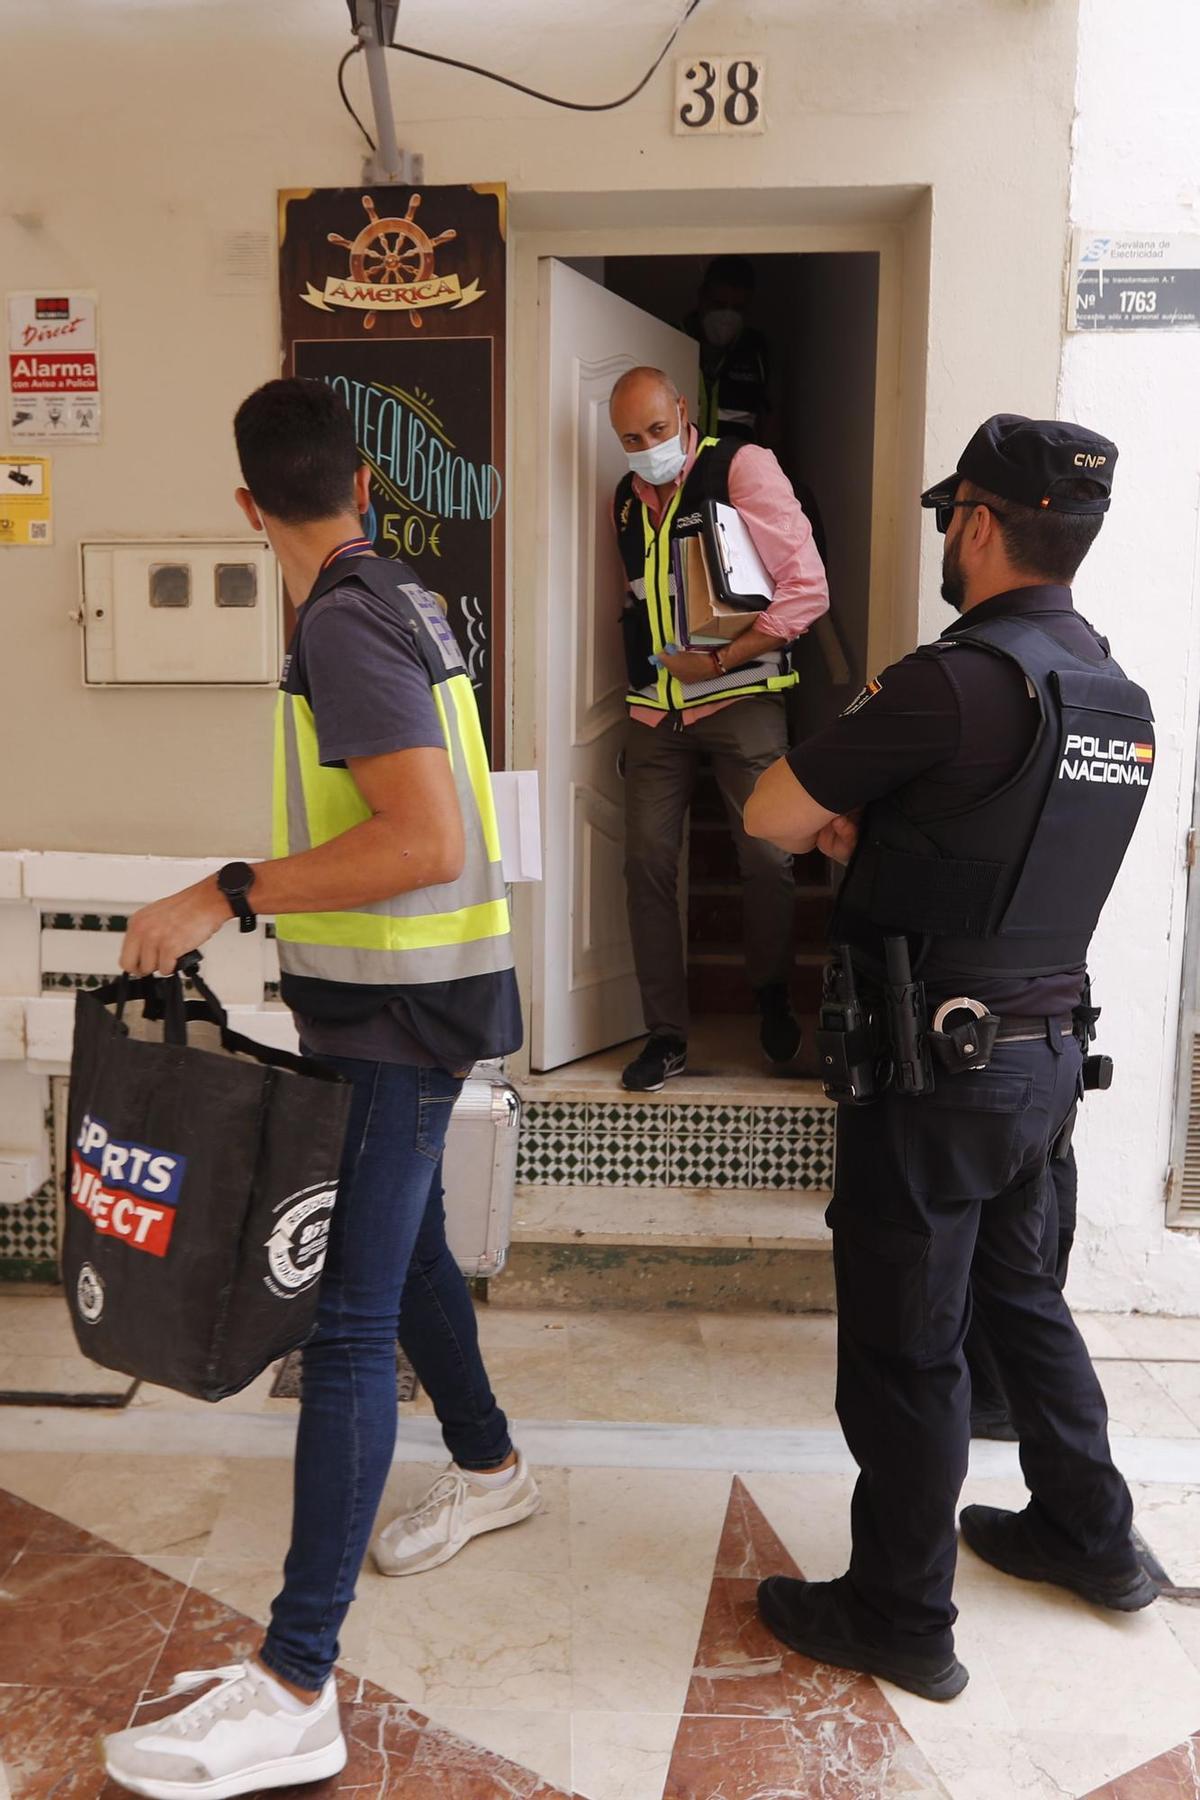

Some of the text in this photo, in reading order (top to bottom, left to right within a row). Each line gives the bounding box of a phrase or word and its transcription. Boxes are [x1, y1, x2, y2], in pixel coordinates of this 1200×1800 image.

[680, 61, 759, 127] 38
[330, 280, 456, 304] AMERICA
[1120, 291, 1157, 312] 1763
[13, 358, 96, 377] Alarma
[303, 375, 502, 520] TEAUBRIAND
[1074, 453, 1106, 468] CNP
[1059, 759, 1149, 785] NACIONAL
[77, 1114, 177, 1193] SPRTS
